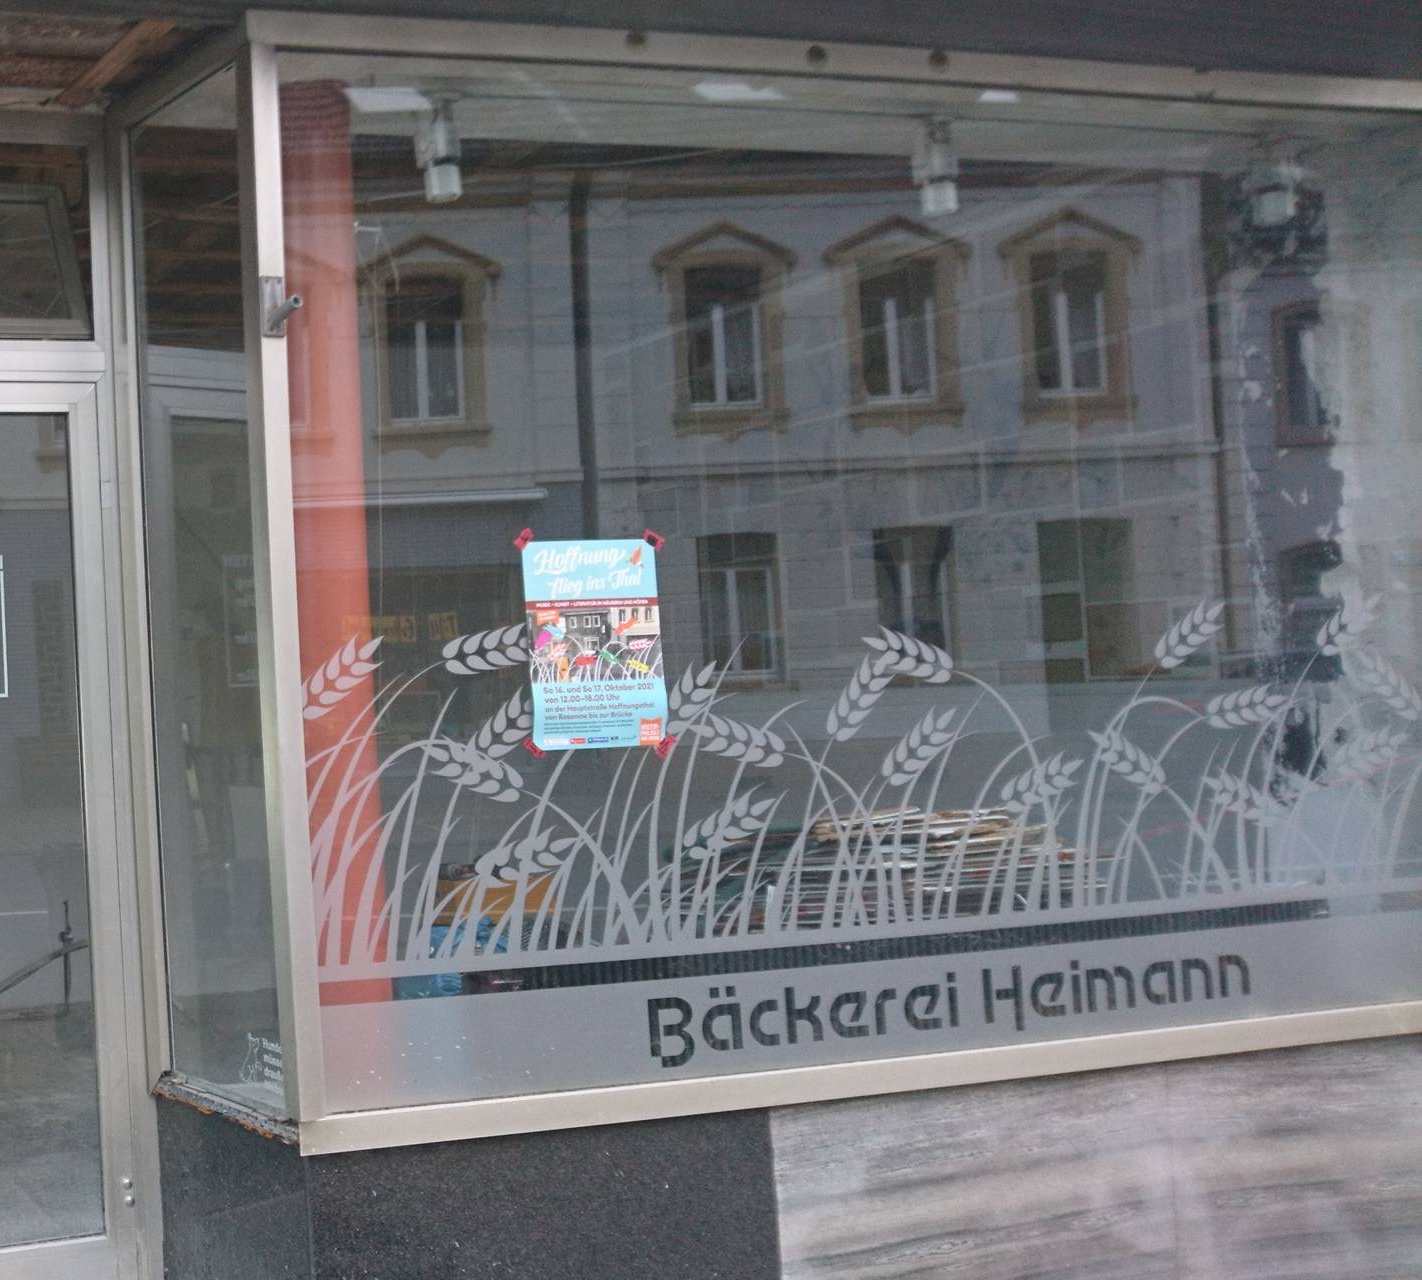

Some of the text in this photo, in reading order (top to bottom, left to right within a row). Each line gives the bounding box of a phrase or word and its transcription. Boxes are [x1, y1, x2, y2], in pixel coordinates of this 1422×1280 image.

[533, 545, 627, 576] Hoffnung
[586, 575, 606, 590] ins
[609, 567, 643, 590] Thal
[583, 685, 592, 693] So
[594, 684, 603, 692] 17.
[604, 683, 636, 691] Oktober
[637, 682, 654, 690] 2021
[606, 693, 620, 701] Uhr
[648, 953, 1251, 1068] Bäckerei Heimann
